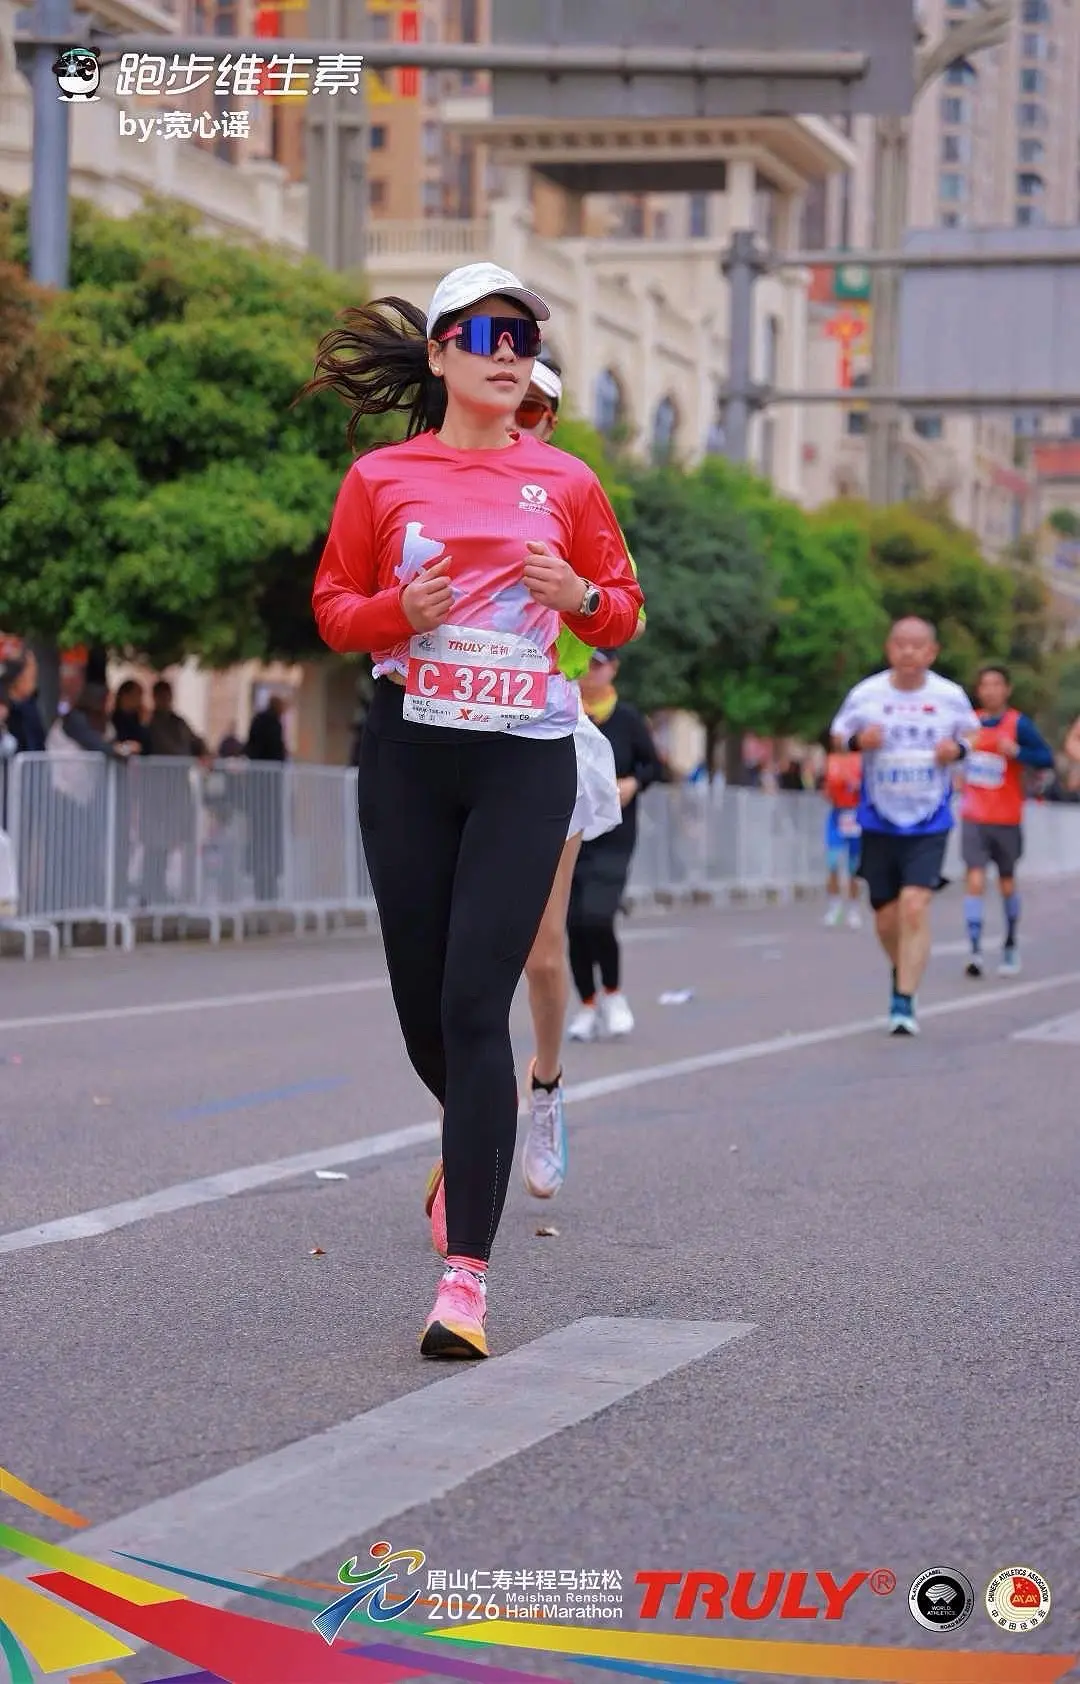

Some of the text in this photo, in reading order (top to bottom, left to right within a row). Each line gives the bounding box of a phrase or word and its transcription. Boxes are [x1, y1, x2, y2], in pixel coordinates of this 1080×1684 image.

[448, 640, 486, 653] TRULY
[418, 663, 534, 707] C 3212
